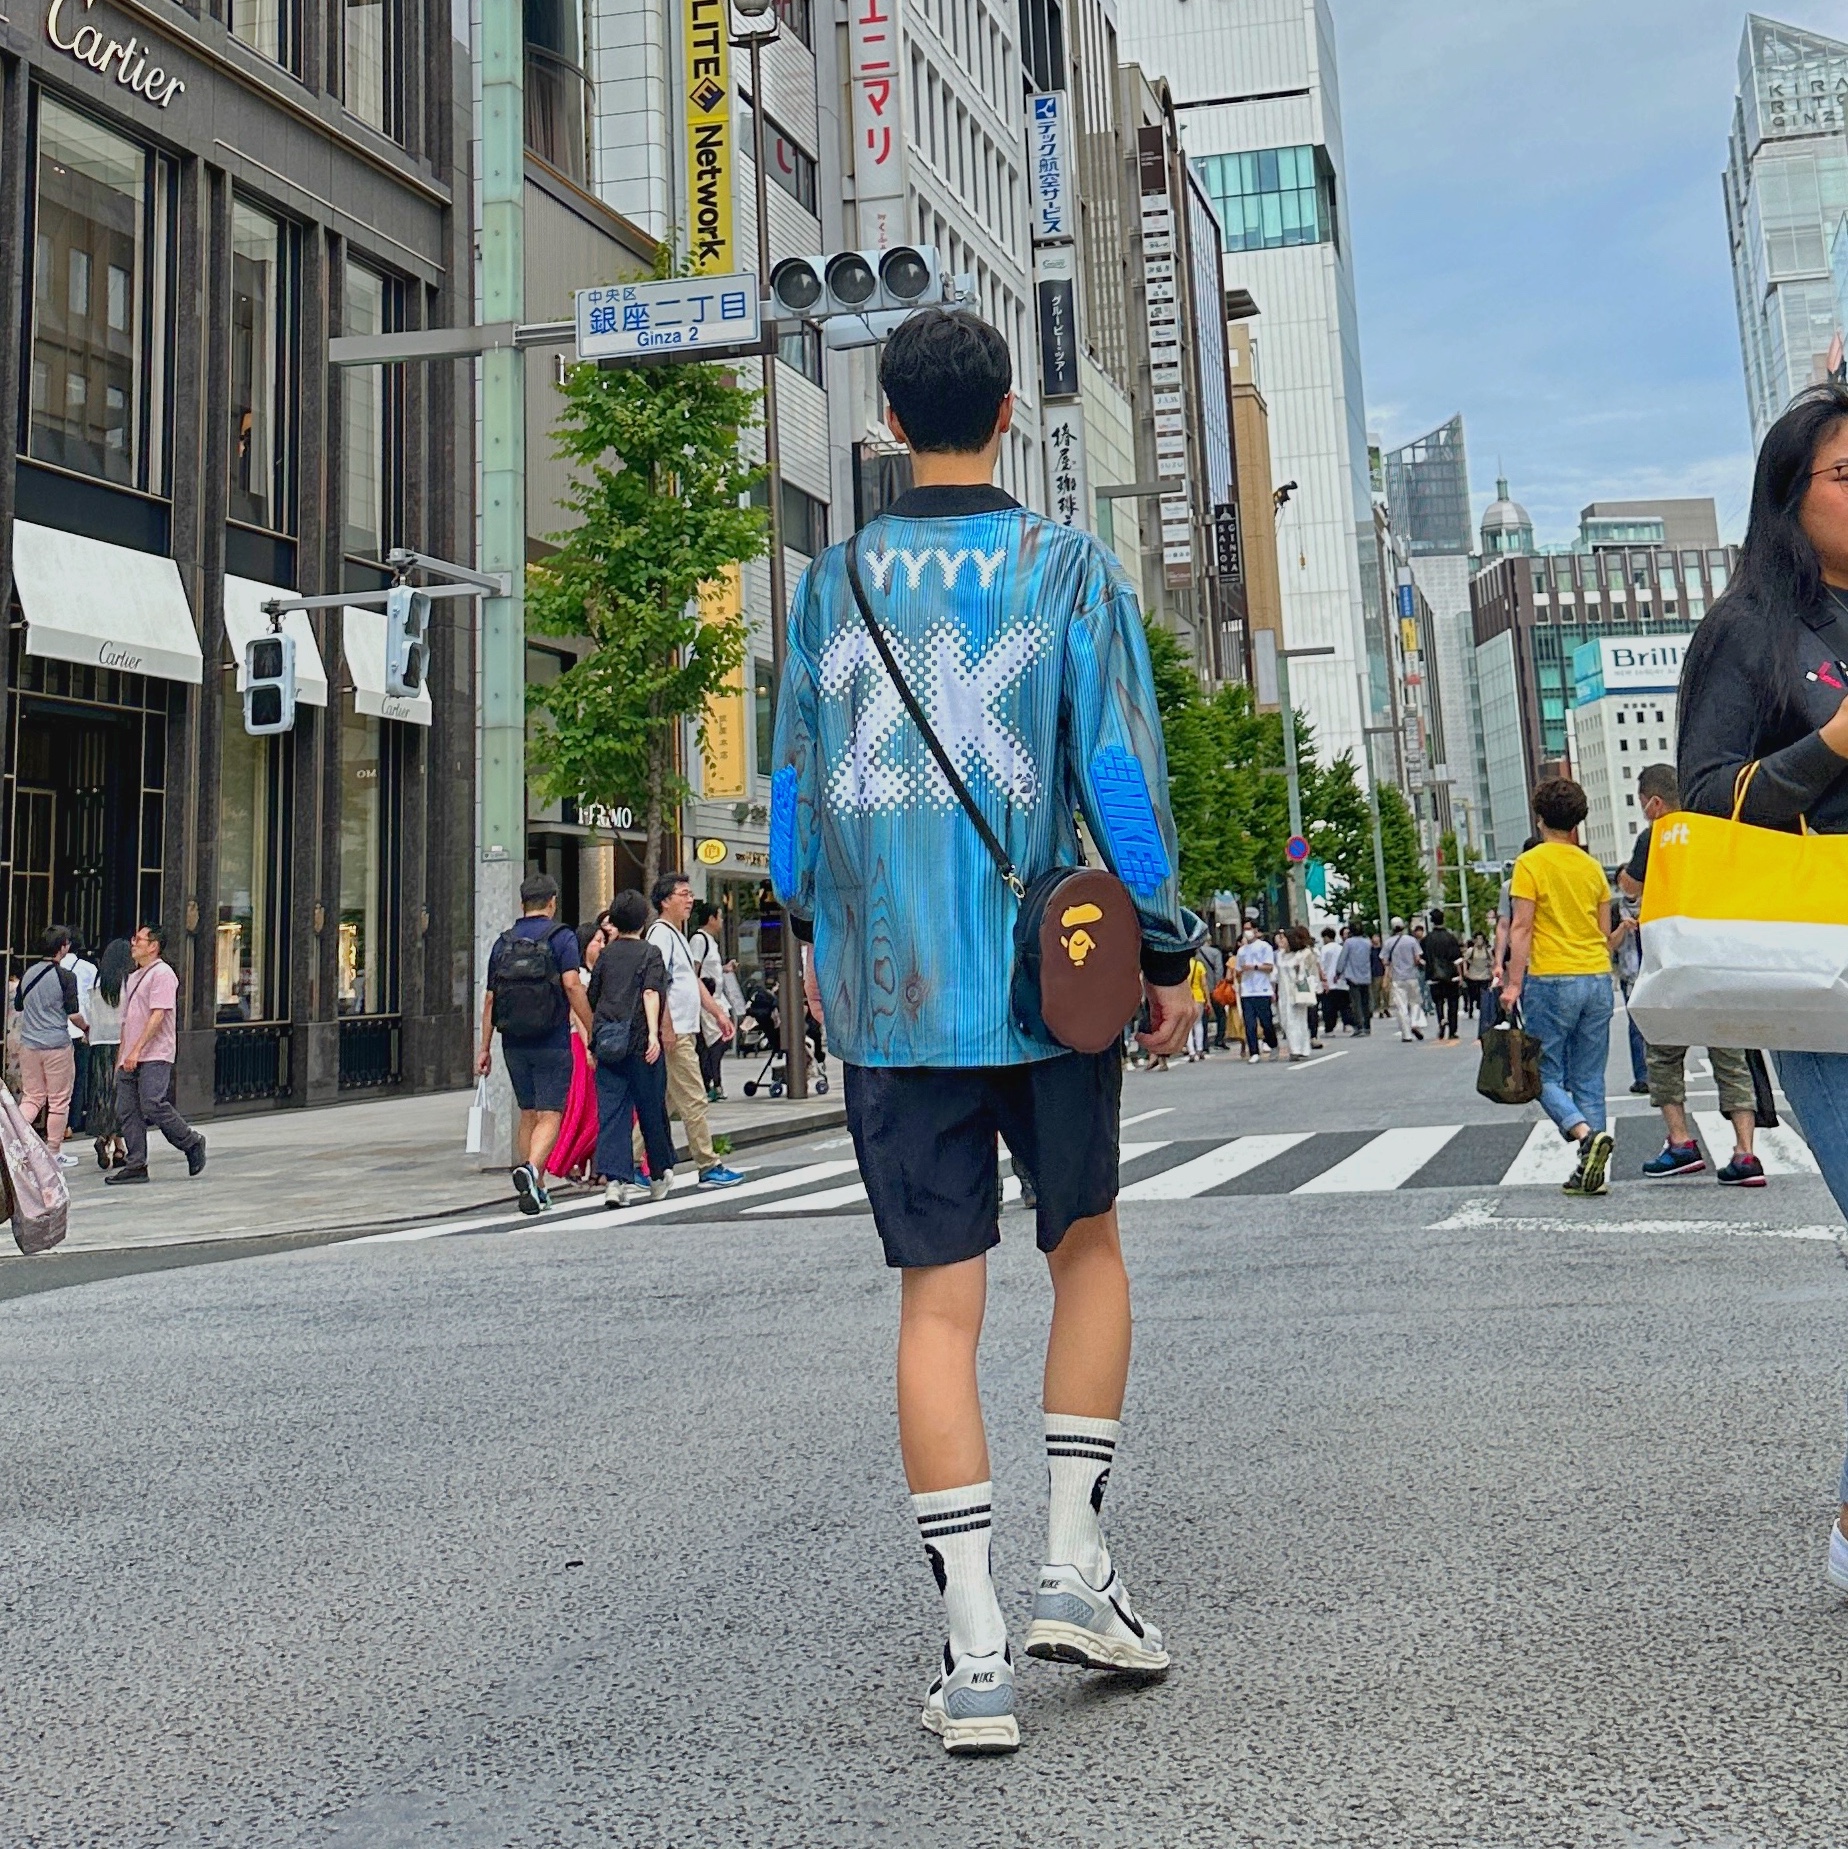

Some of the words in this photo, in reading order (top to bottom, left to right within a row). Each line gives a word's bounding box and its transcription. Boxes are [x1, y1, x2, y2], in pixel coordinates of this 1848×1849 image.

[46, 0, 186, 108] Cartier
[1037, 121, 1062, 234] テック航空サービス
[588, 286, 637, 304] 中央区
[589, 291, 747, 335] 銀座二丁目
[637, 330, 682, 347] Ginza
[688, 326, 699, 342] 2
[1218, 524, 1228, 572] SALON
[1228, 523, 1238, 572] GINZA
[99, 640, 142, 670] Cartier
[381, 695, 411, 718] Cartier
[1098, 777, 1163, 865] NIKE
[1041, 1579, 1060, 1588] NIKE
[972, 1672, 995, 1683] NIKE
